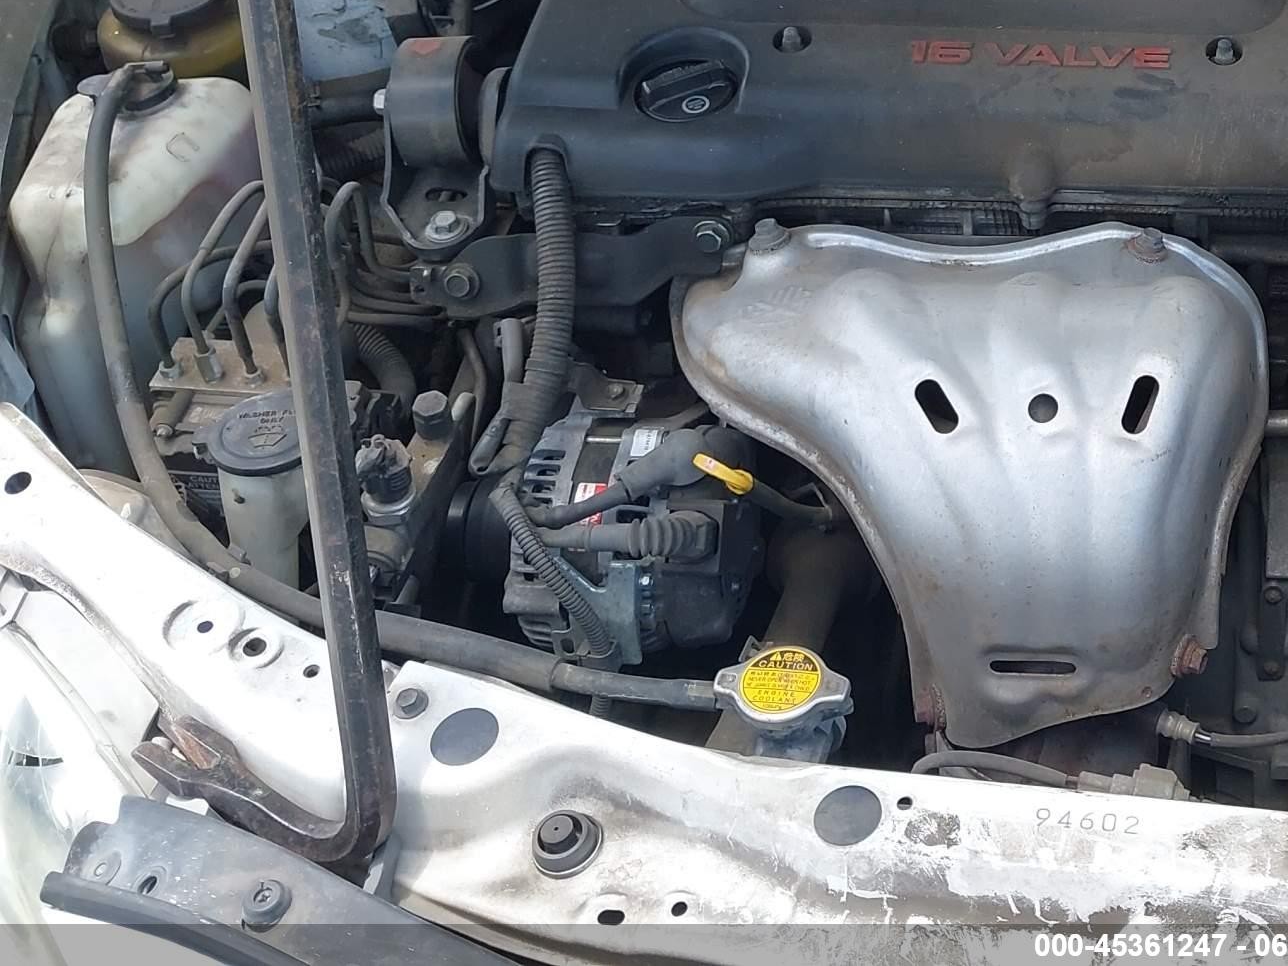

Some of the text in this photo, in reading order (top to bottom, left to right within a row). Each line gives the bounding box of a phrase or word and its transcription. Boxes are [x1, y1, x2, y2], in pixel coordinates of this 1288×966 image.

[912, 40, 1173, 69] 16 VALVE
[758, 660, 813, 671] CAUTION
[752, 695, 797, 704] COOLANT
[757, 690, 795, 698] ENGINE
[1036, 808, 1139, 835] 94602
